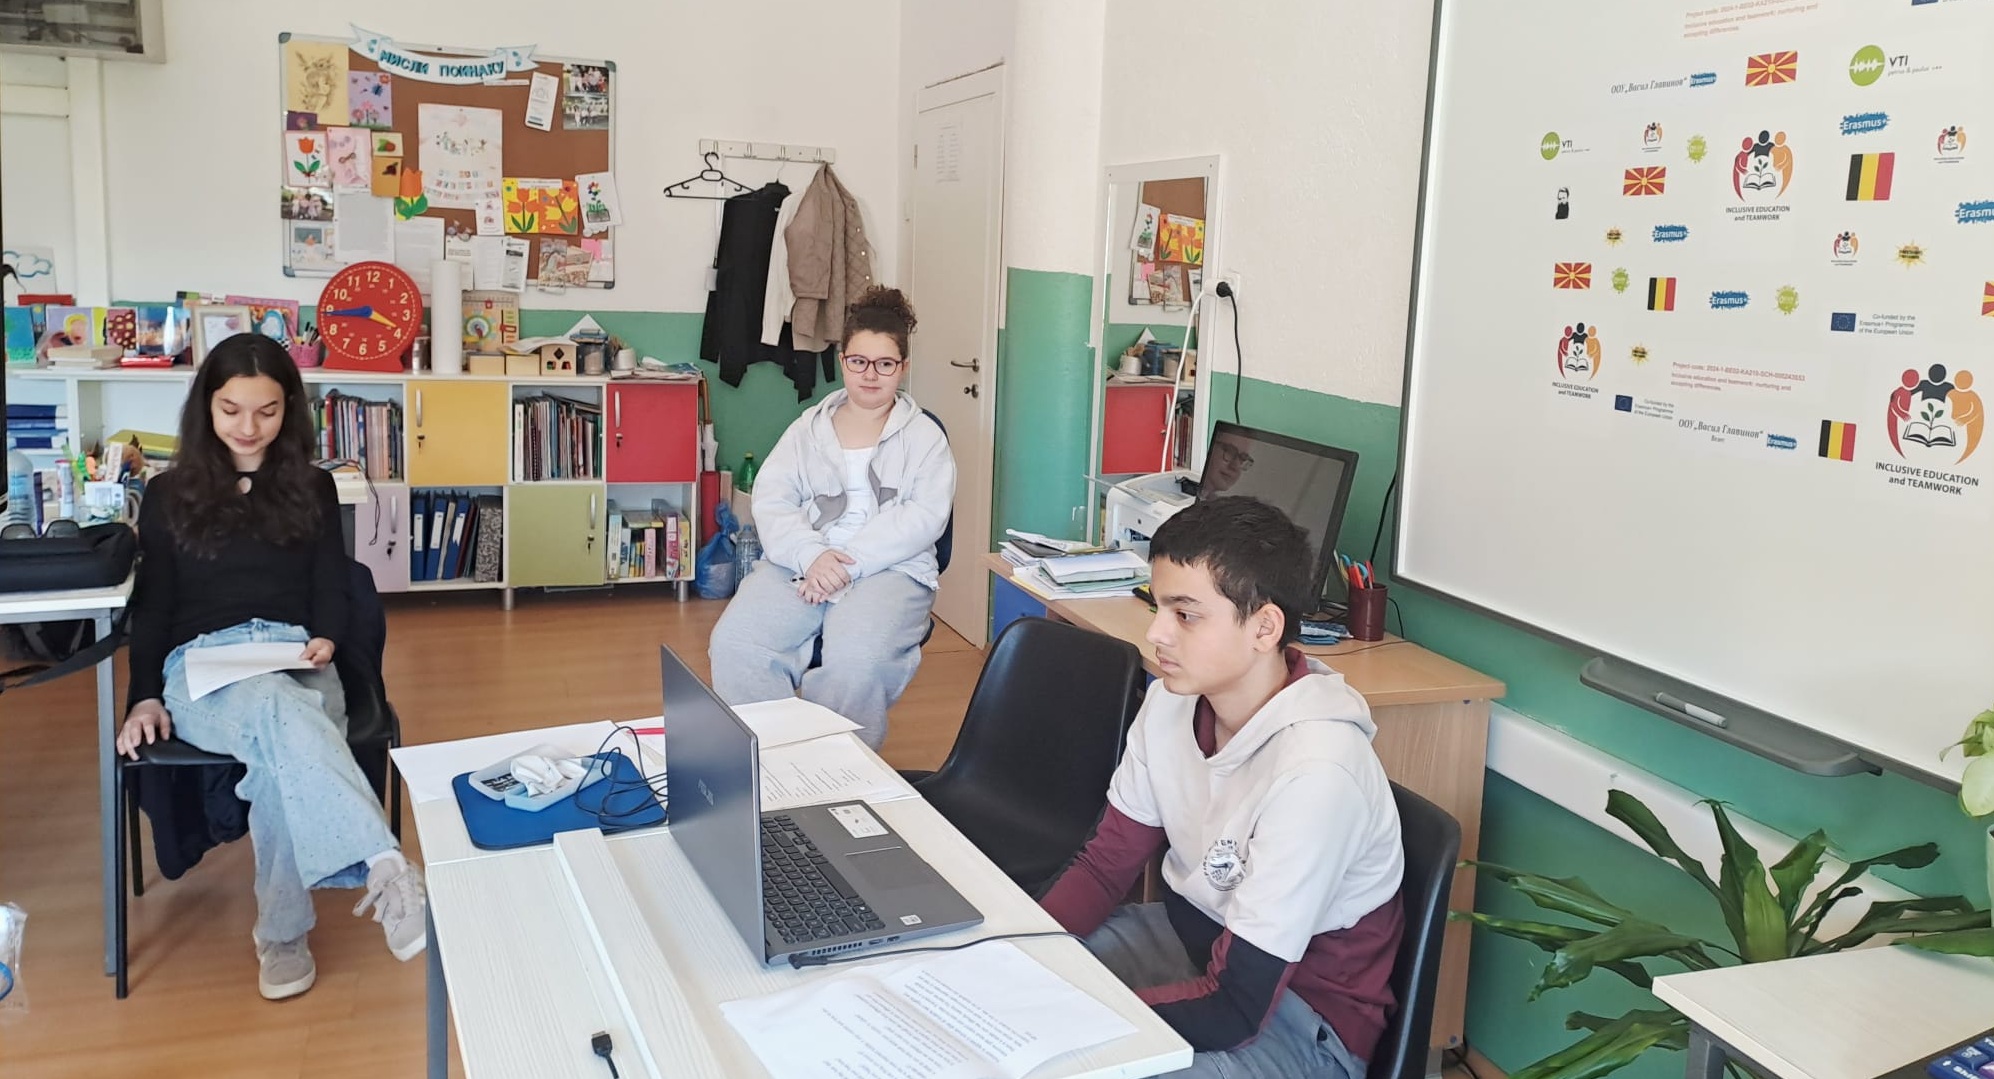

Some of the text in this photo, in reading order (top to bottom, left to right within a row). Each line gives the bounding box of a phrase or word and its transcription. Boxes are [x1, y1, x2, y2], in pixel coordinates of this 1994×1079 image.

[380, 50, 504, 80] МИСЛИ ПОИНАКУ
[1889, 55, 1909, 67] VTI
[1561, 139, 1573, 148] VTI
[1725, 204, 1791, 214] INCLUSIVE EDUCATION
[348, 275, 360, 288] 11
[367, 271, 380, 282] 12
[389, 278, 395, 289] 1
[333, 288, 348, 300] 10
[400, 292, 408, 304] 2
[402, 309, 410, 321] 3
[329, 323, 337, 335] 8
[393, 328, 401, 339] 4
[342, 338, 351, 350] 7
[358, 343, 367, 355] 6
[378, 340, 387, 352] 5
[1875, 461, 1979, 486] INCLUSIVE EDUCATION
[1888, 477, 1962, 495] and TEAMWORK
